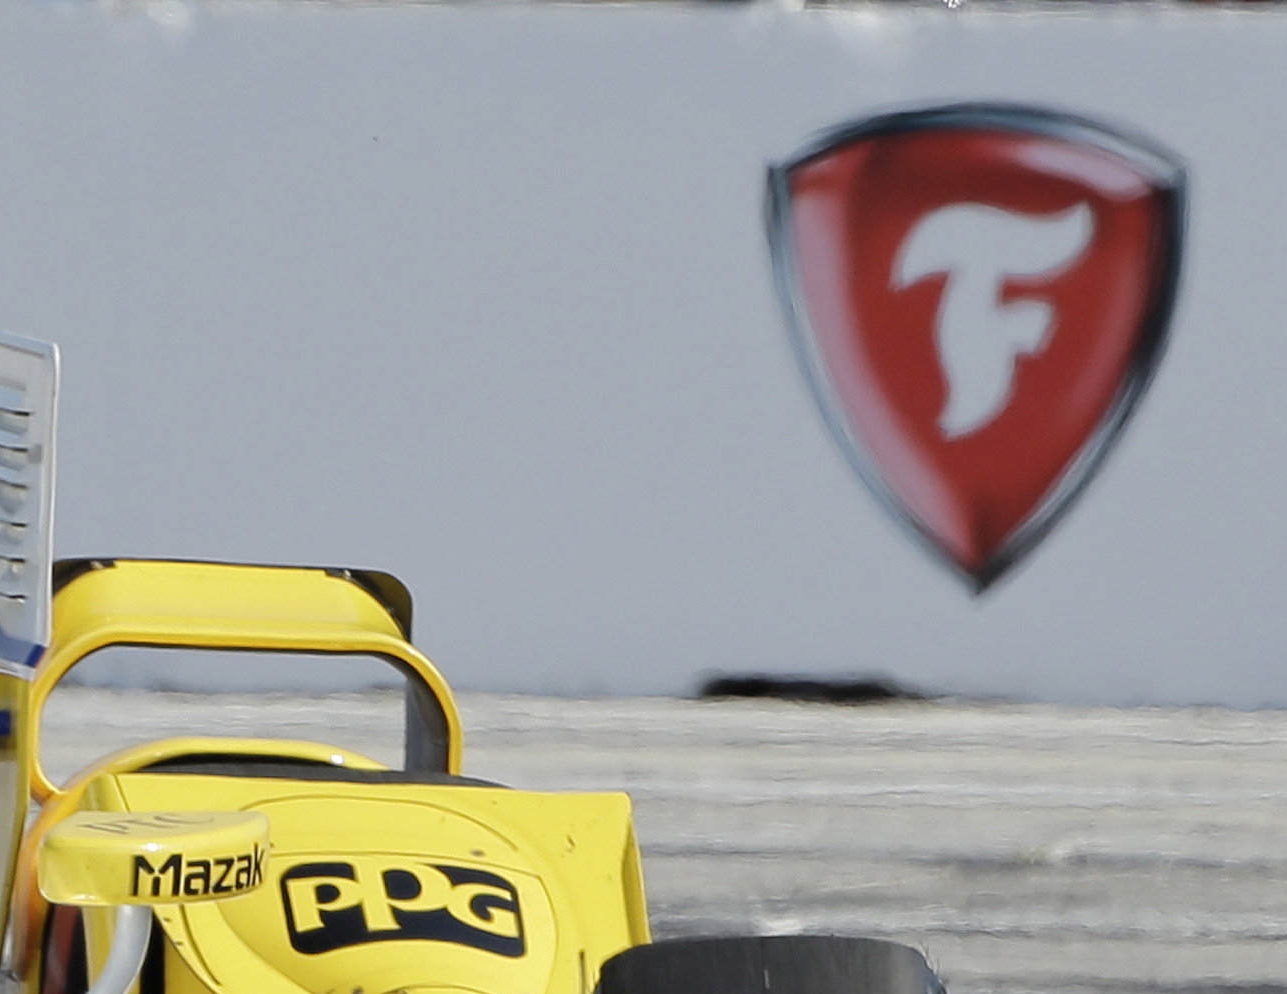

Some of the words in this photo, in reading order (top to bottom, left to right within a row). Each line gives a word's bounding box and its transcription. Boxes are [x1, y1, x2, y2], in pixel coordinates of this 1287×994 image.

[889, 199, 1097, 442] F
[130, 842, 267, 897] Mazak
[285, 862, 522, 939] PPG
